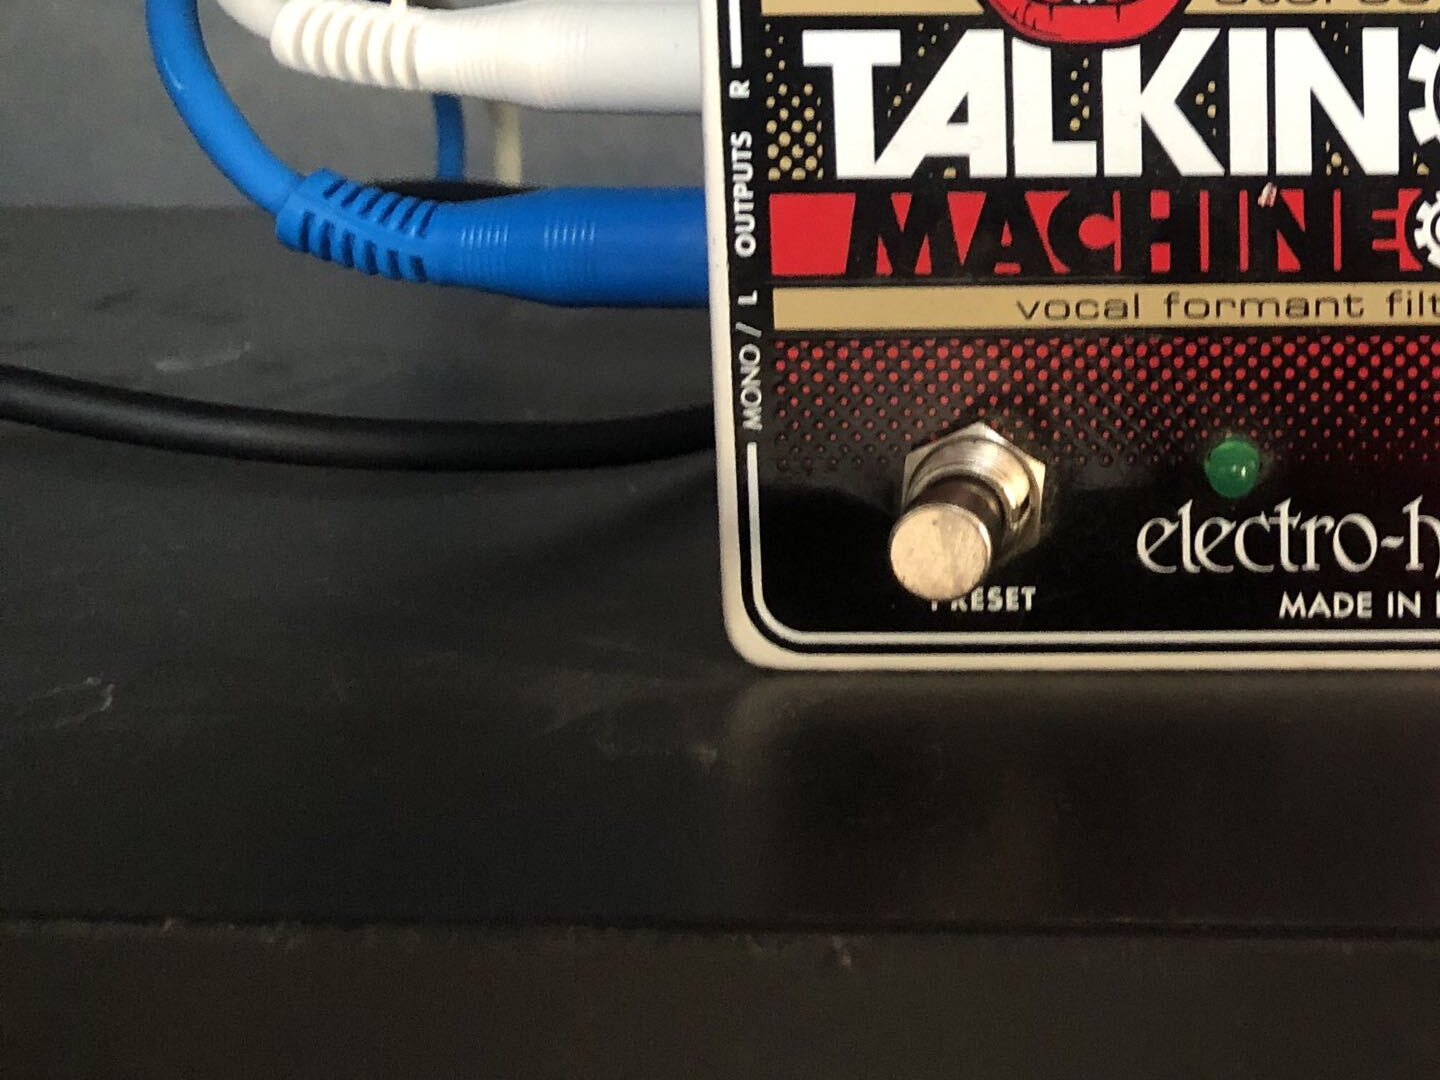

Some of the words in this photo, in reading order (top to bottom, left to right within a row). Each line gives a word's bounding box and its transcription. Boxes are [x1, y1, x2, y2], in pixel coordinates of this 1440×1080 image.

[729, 79, 750, 99] R
[731, 131, 756, 258] OUTPUTS
[845, 190, 1408, 274] MACHINE
[1017, 292, 1140, 321] vocal
[1165, 291, 1366, 321] formant
[930, 585, 1037, 612] ESET
[1279, 591, 1372, 619] MADE
[1387, 591, 1421, 618] IN
